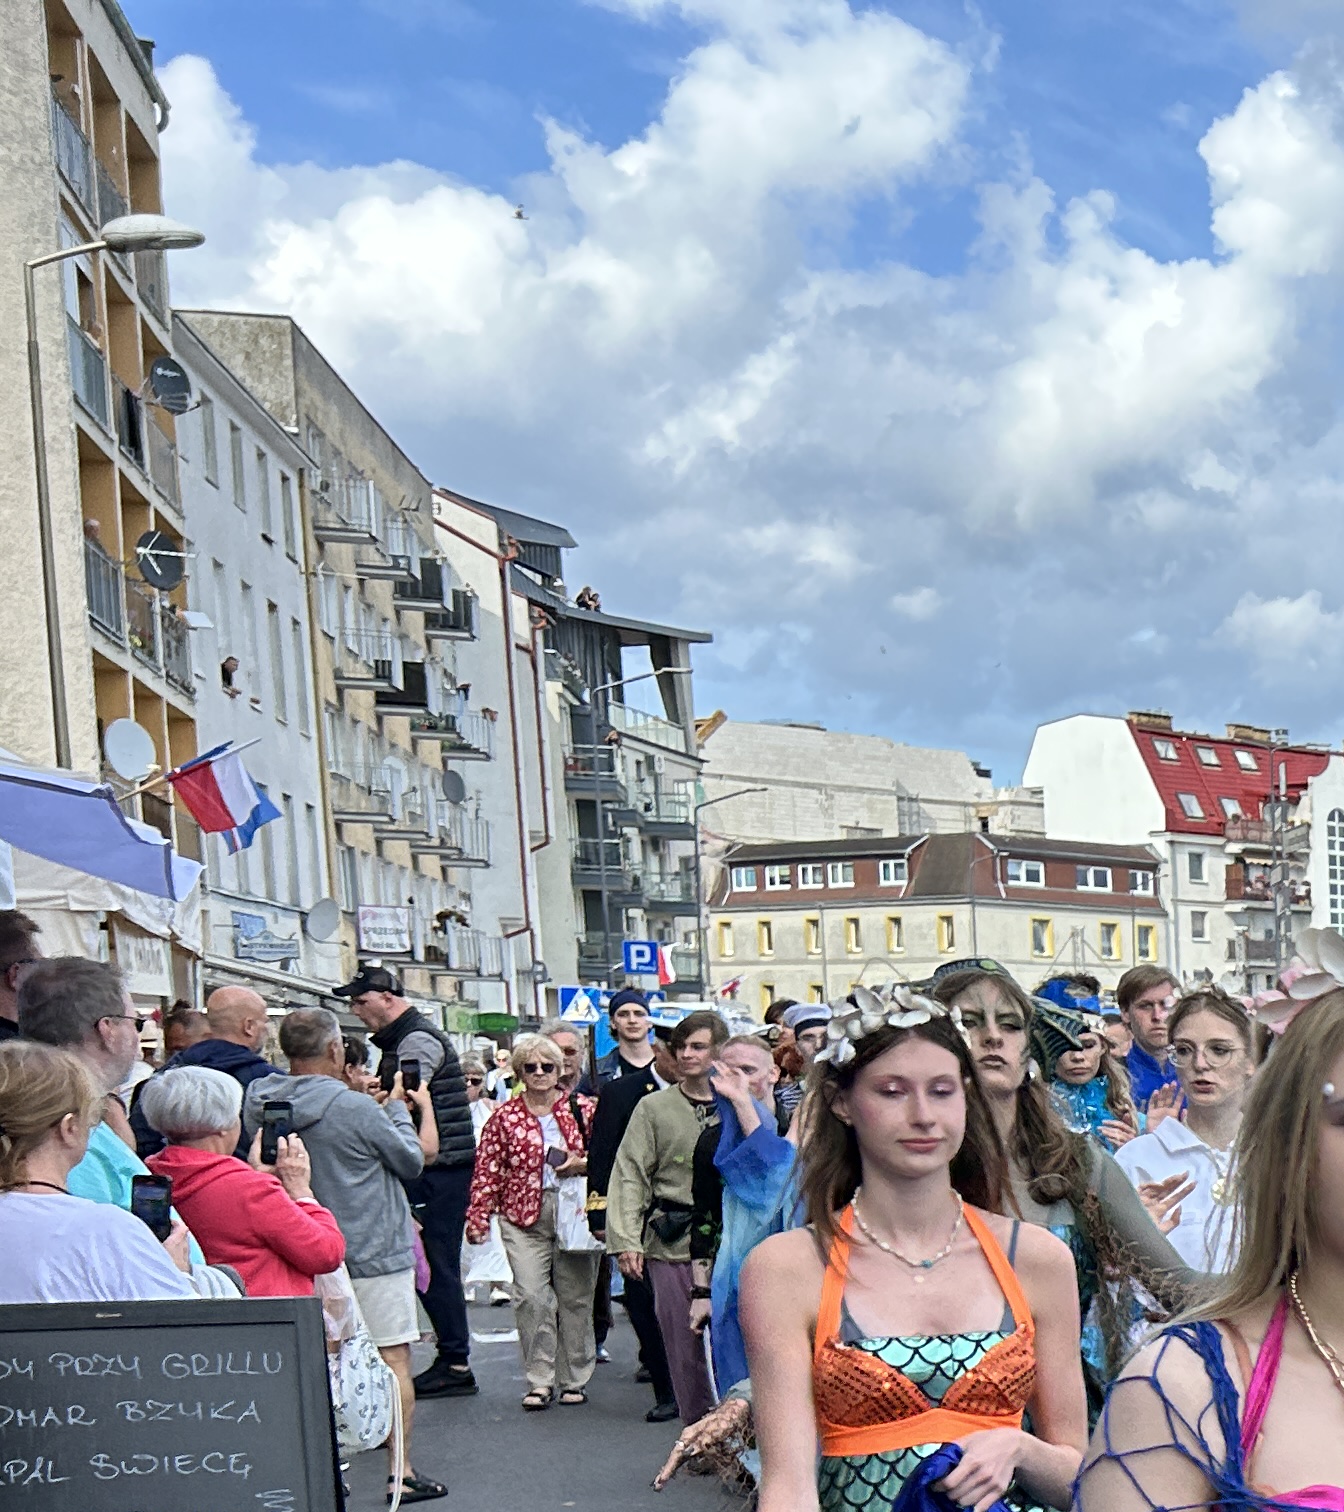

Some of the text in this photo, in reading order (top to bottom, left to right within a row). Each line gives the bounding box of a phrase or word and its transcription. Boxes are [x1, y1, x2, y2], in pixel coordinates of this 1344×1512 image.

[630, 944, 651, 970] P
[161, 1350, 283, 1380] GRILLU
[115, 1399, 262, 1425] BZYKA
